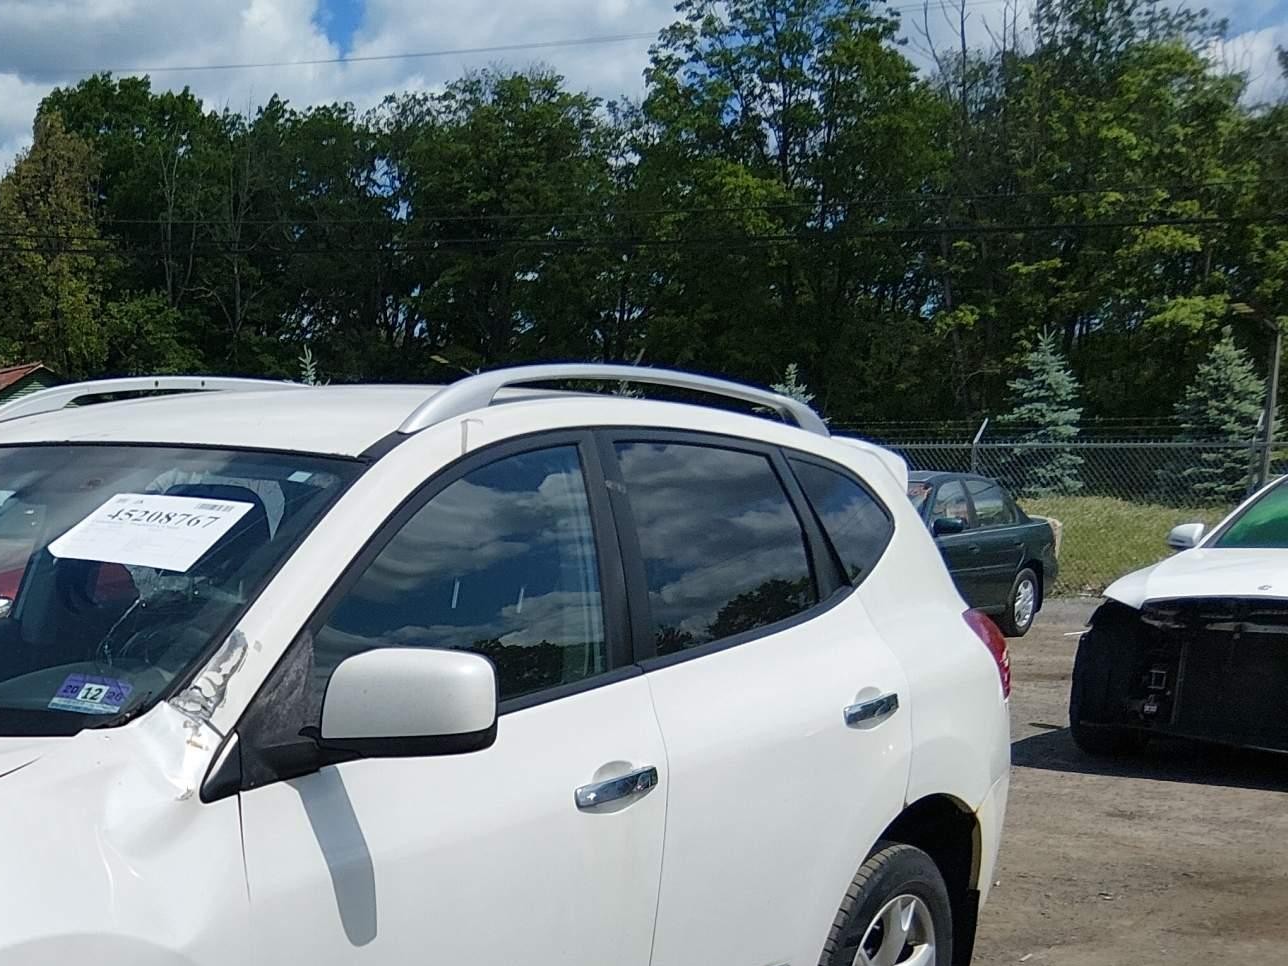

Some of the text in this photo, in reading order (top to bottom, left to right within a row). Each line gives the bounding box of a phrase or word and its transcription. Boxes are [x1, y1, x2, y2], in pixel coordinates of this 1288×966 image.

[107, 508, 221, 529] 45208767
[62, 684, 79, 694] 20
[81, 686, 104, 701] 12
